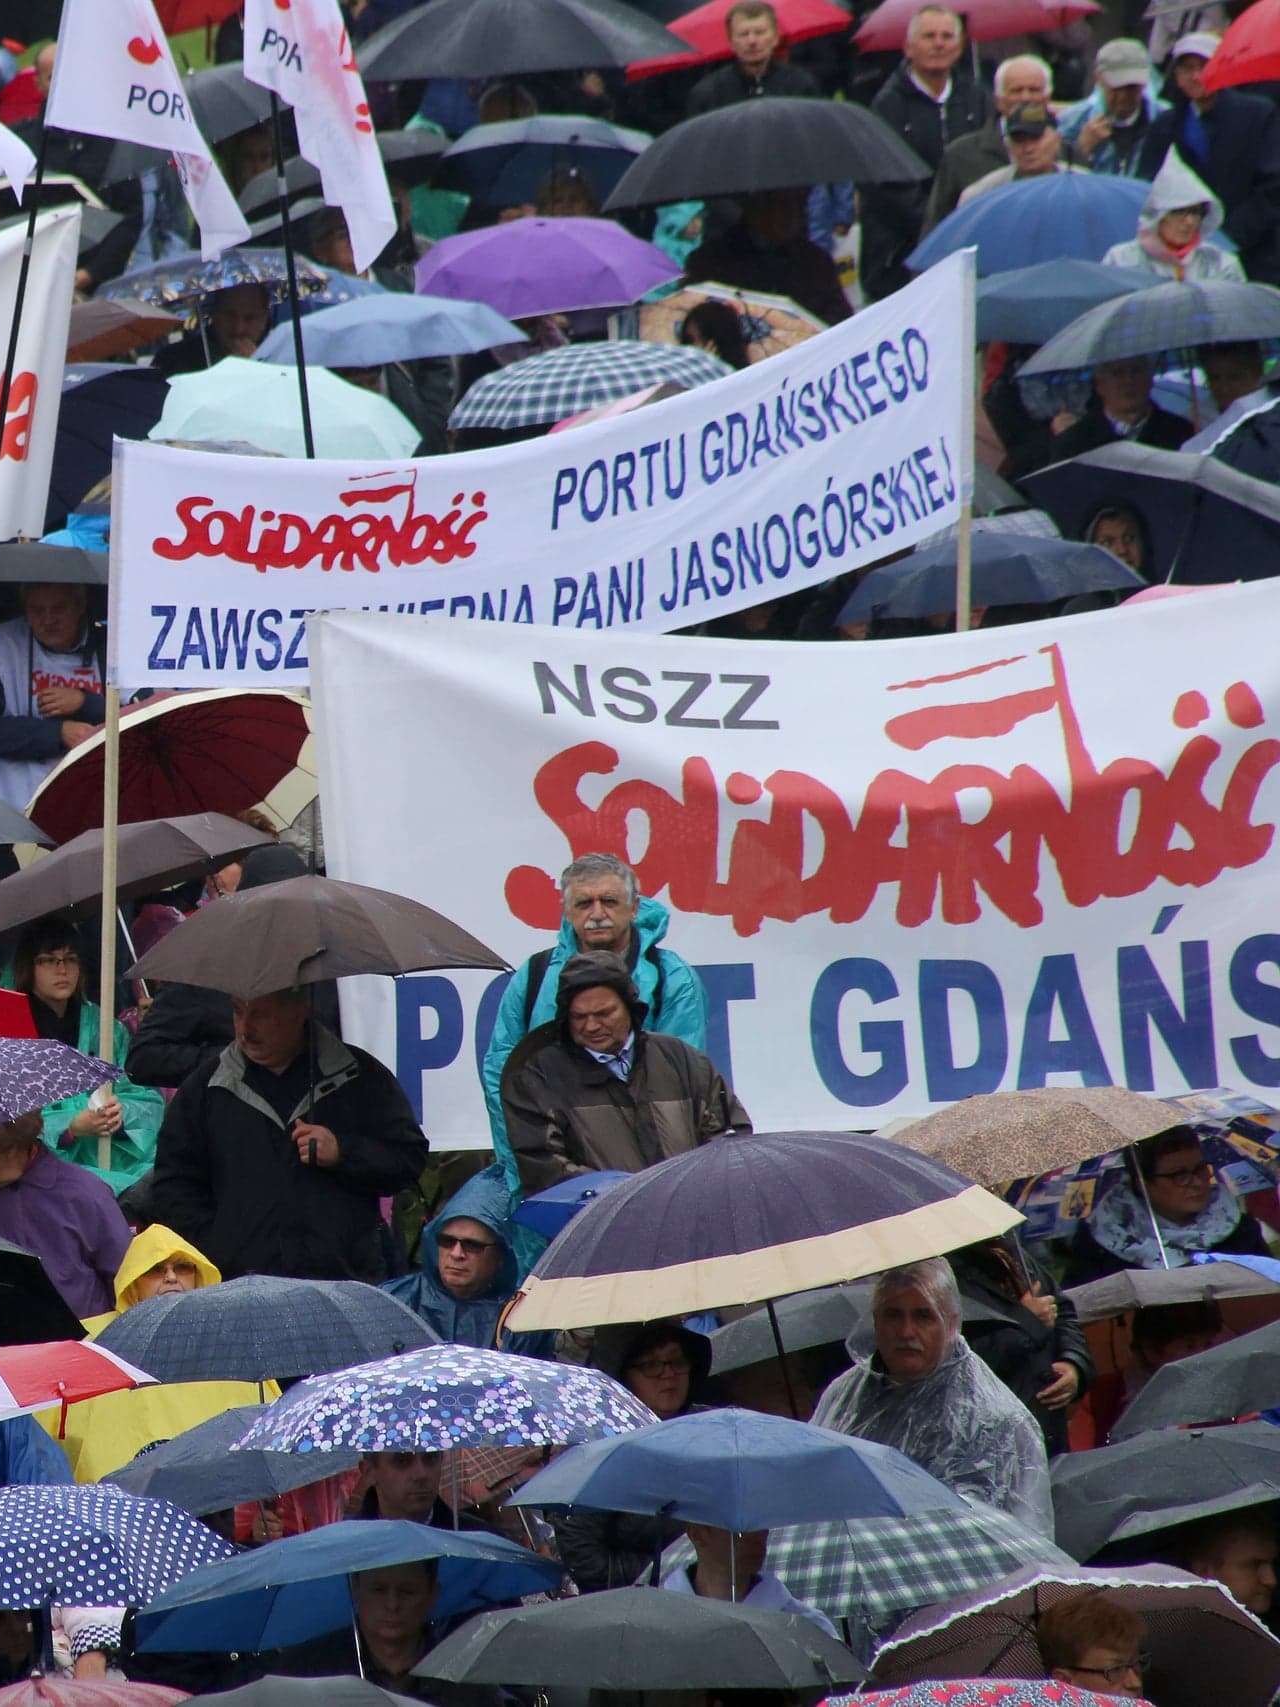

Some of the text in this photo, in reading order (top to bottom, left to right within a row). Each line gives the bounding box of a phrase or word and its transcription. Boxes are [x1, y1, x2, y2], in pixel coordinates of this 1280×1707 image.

[126, 84, 187, 122] POR
[551, 328, 930, 531] PORTU GDAŃSKIEGO
[147, 605, 311, 671] ZAWSZ
[552, 557, 645, 630] PANI
[659, 436, 957, 612] JASNOGÓRSKIEJ
[532, 661, 780, 730] NSZZ
[394, 963, 757, 1125] PT
